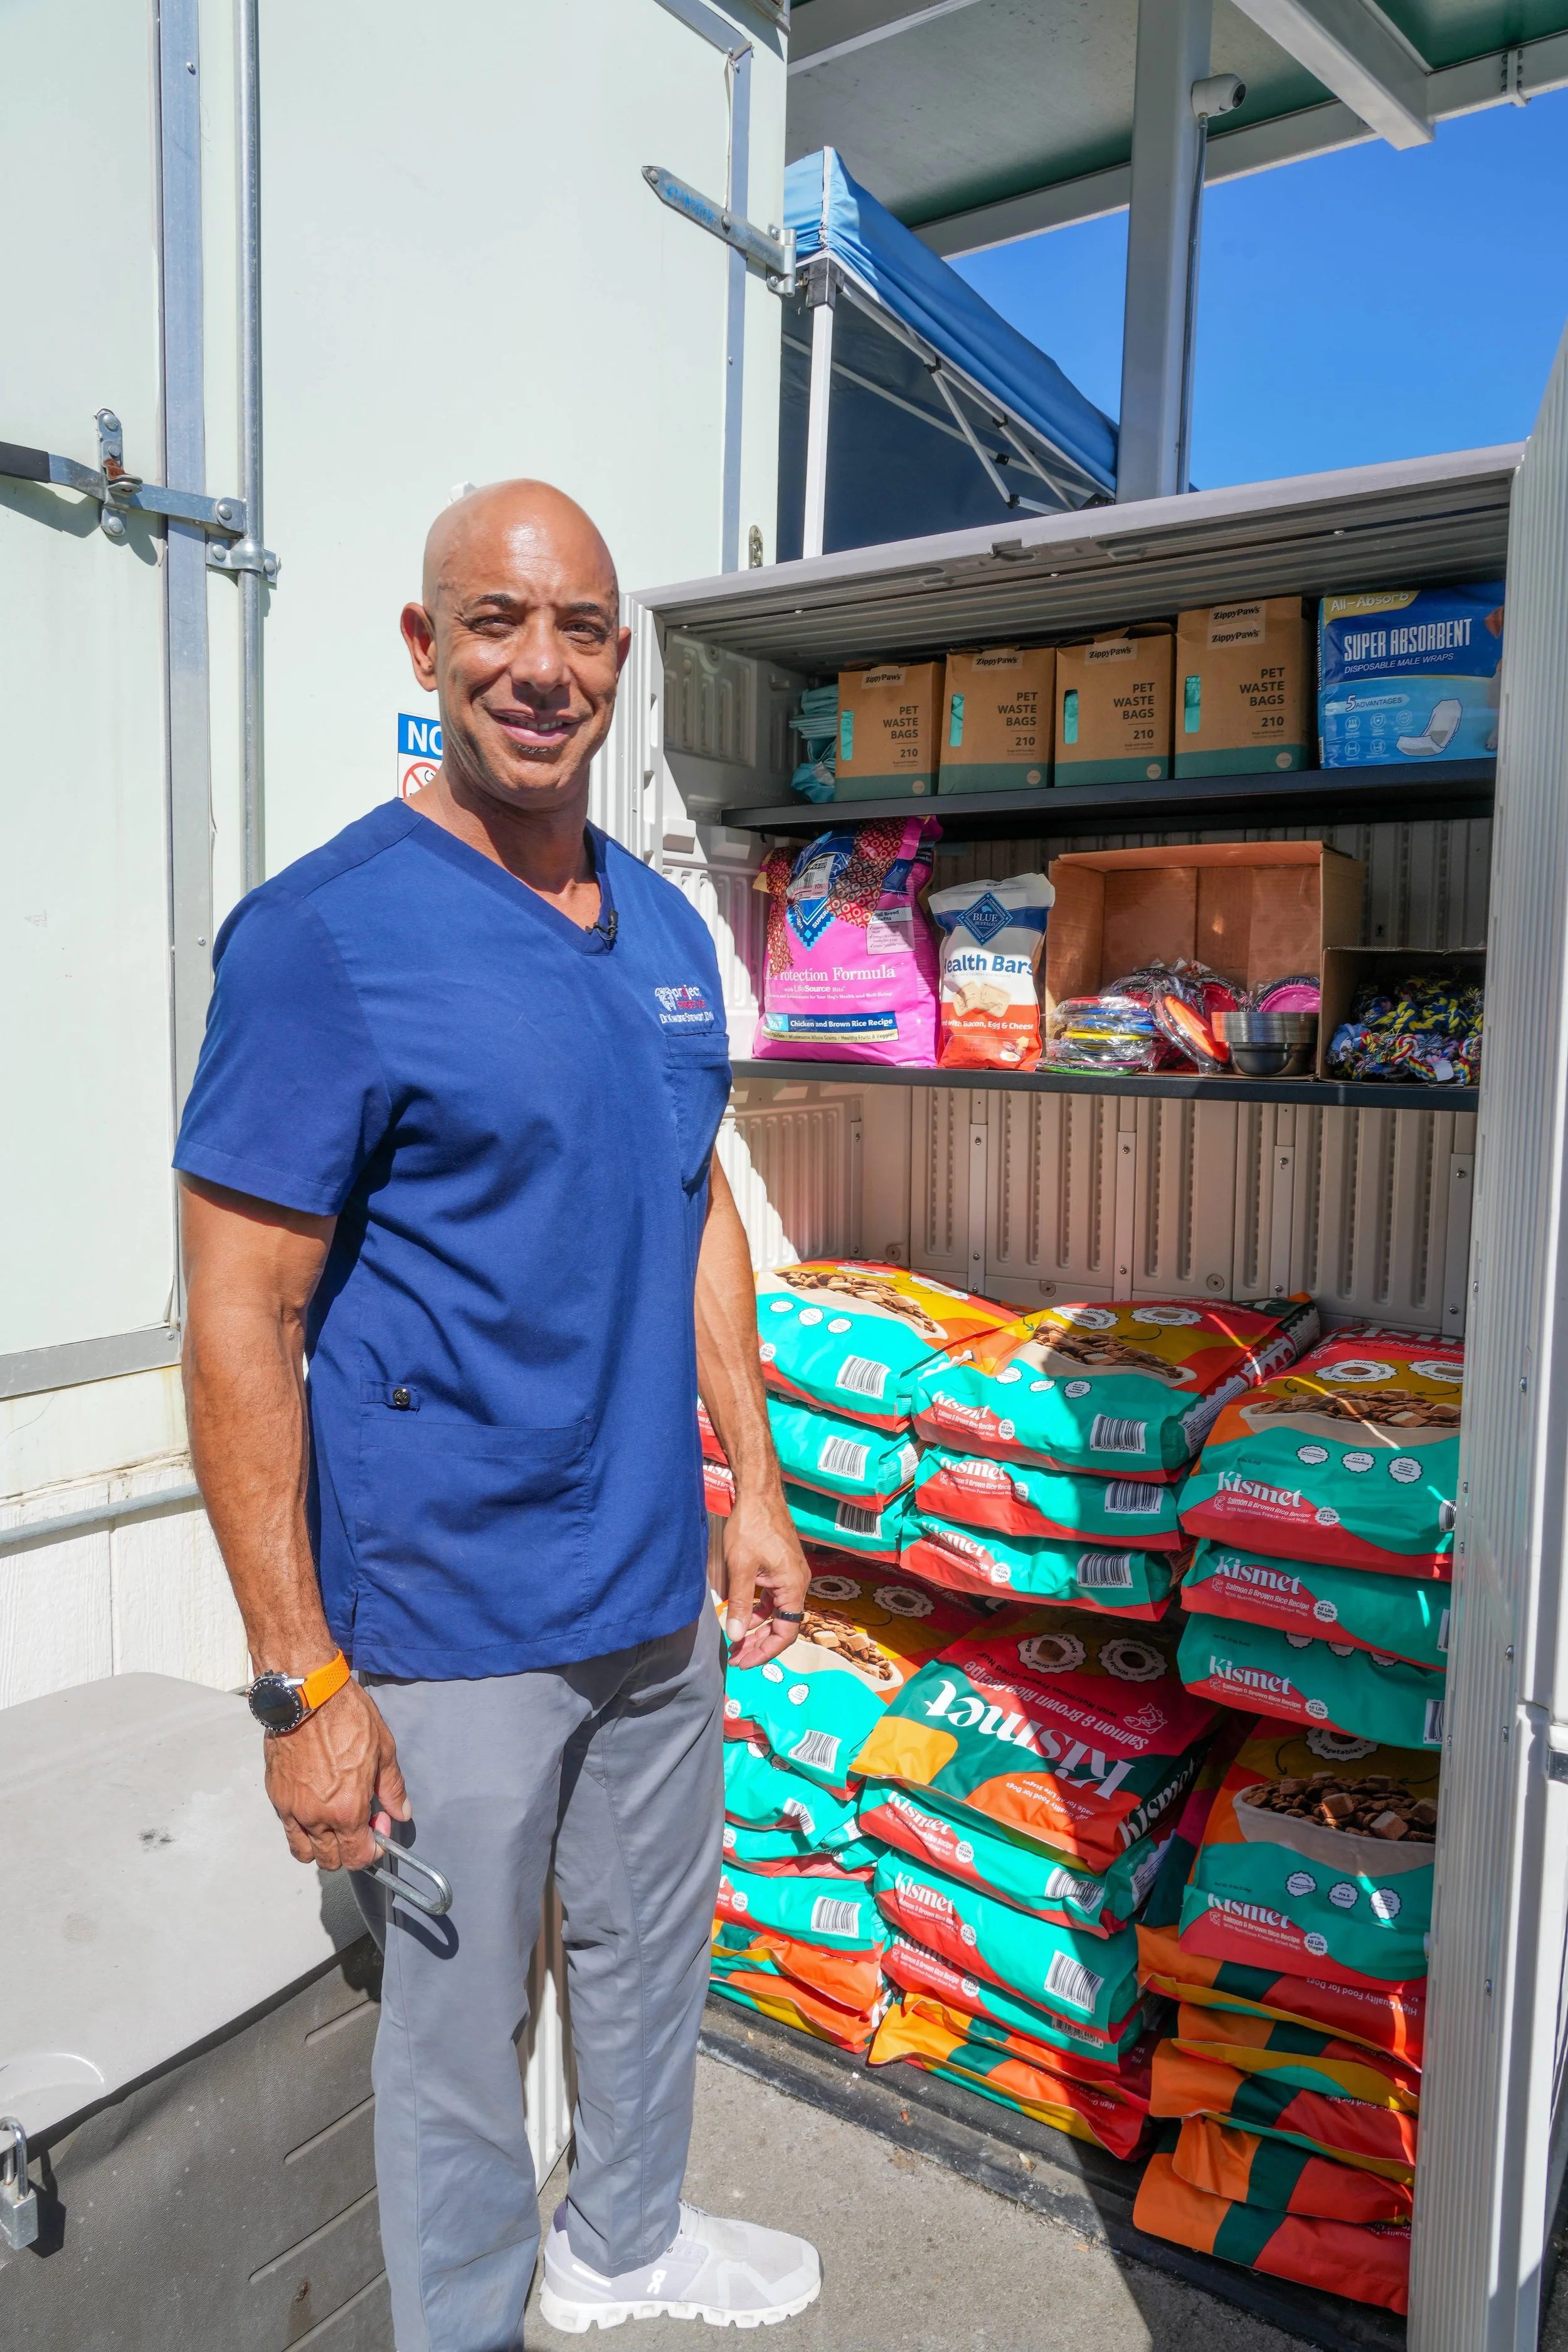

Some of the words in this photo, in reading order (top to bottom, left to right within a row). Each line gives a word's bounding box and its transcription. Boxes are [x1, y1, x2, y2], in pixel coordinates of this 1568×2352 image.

[1331, 592, 1409, 612] All-Absorb
[1344, 630, 1386, 662] SUPER
[1390, 618, 1472, 656] ABSORBENT
[1345, 660, 1395, 674] DISPOSABLE
[1397, 657, 1420, 667] MALE
[1422, 653, 1454, 663] WRAPS
[1261, 667, 1285, 678] PET
[1133, 683, 1155, 692] PET
[1239, 681, 1285, 694] WASTE
[1017, 692, 1038, 702] PET
[1113, 696, 1155, 707] WASTE
[1249, 694, 1285, 706] BAGS
[1345, 695, 1357, 712] 5
[1356, 697, 1402, 709] ADVANTAGES
[899, 706, 918, 716] PET
[997, 704, 1037, 714] WASTE
[1123, 709, 1155, 720] BAGS
[883, 718, 918, 728] WASTE
[1006, 716, 1036, 726] BAGS
[1261, 717, 1285, 727] 210
[891, 728, 918, 739] BAGS
[1133, 730, 1153, 739] 210
[1015, 737, 1036, 746] 210
[900, 748, 918, 758] 210
[973, 913, 998, 921] BLUE
[992, 955, 1033, 976] Bars
[832, 965, 896, 981] Formula
[867, 1018, 893, 1027] Recipe
[938, 1409, 951, 1419] Salmon
[955, 1414, 968, 1426] Brown
[968, 1420, 978, 1429] Rice
[979, 1422, 996, 1431] Recipe
[969, 1479, 985, 1488] Brown
[1217, 1471, 1303, 1508] Kismet
[1227, 1496, 1248, 1506] Salmon
[1253, 1502, 1274, 1512] Brown
[1275, 1507, 1289, 1515] Rice
[1262, 1512, 1295, 1522] Freeze-Dried
[1214, 1555, 1303, 1595] Kismet
[1226, 1582, 1248, 1593] Salmon
[1253, 1589, 1273, 1601] Brown
[1274, 1596, 1288, 1604] Rice
[1289, 1599, 1310, 1610] Recipe
[1237, 1594, 1261, 1605] Nutritious
[1262, 1601, 1295, 1613] Freeze-Dried
[963, 1661, 1007, 1692] Recipe
[995, 1665, 1051, 1690] Freeze-Dried
[1209, 1655, 1292, 1695] Kismet
[1007, 1685, 1037, 1702] Rice
[1051, 1687, 1094, 1709] Nutritious
[1222, 1682, 1242, 1692] Salmon
[1249, 1689, 1268, 1700] Brown
[1268, 1695, 1281, 1703] Rice
[1281, 1697, 1301, 1708] Recipe
[1034, 1694, 1085, 1722] Brown
[1097, 1707, 1118, 1719] With
[924, 1680, 1135, 1801] Kismet
[1094, 1724, 1150, 1751] Salmon
[1320, 1744, 1362, 1755] Vegetables
[1006, 1782, 1022, 1793] Dogs
[1022, 1779, 1044, 1790] Stages
[1033, 1793, 1051, 1804] Food
[1044, 1788, 1057, 1798] Life
[1067, 1799, 1078, 1808] for
[887, 1791, 952, 1835] Kismet
[1050, 1803, 1074, 1818] Quality
[1078, 1805, 1096, 1816] Made
[938, 1837, 954, 1850] Recipe
[895, 1870, 955, 1914] Kismet
[919, 1907, 935, 1918] Brown
[935, 1913, 946, 1921] Rice
[1208, 1893, 1290, 1929] Kismet
[1223, 1914, 1242, 1926] Salmon
[1248, 1922, 1267, 1934] Brown
[1268, 1929, 1279, 1937] Rice
[1281, 1932, 1300, 1944] Recipe
[1234, 1927, 1257, 1937] Nutritious
[1258, 1933, 1288, 1946] Freeze-Dried
[901, 1952, 916, 1963] Salmon
[919, 1961, 934, 1973] Brown
[935, 1968, 944, 1976] Rice
[944, 1973, 959, 1984] Recipe
[909, 1963, 924, 1975] Nutritious
[925, 1971, 948, 1986] Freeze-Dried
[1306, 1977, 1327, 1989] Dogs
[1328, 1984, 1340, 1993] for
[1342, 1988, 1364, 2000] Food
[1365, 1993, 1396, 2010] Quality
[1397, 2003, 1417, 2016] High
[1100, 2100, 1115, 2110] High
